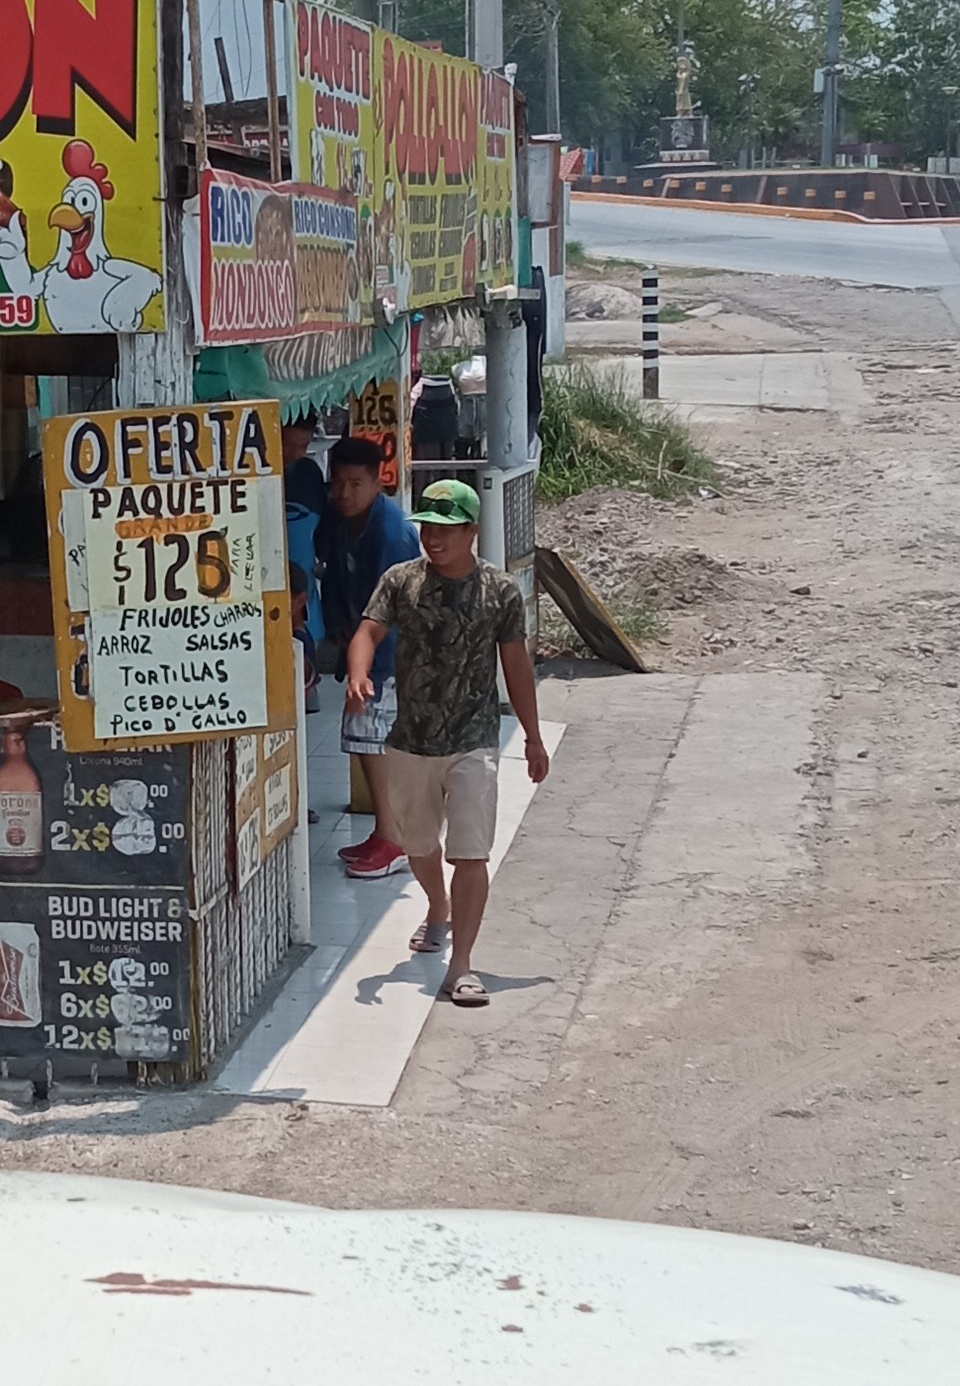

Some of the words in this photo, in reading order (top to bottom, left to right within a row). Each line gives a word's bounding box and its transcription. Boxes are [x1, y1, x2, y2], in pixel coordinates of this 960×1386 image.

[297, 2, 371, 100] PAQUETE
[211, 185, 253, 246] RICO
[294, 199, 317, 234] RICO
[0, 294, 33, 325] 59
[210, 258, 295, 330] MONDONGO
[65, 408, 272, 487] OFERTA
[89, 479, 249, 519] PAQUETE
[119, 605, 210, 631] FRIJOLES
[97, 634, 152, 656] ARROZ
[185, 631, 252, 651] SALSAS
[124, 692, 230, 712] CEBOLLAS
[48, 896, 94, 916] BUD
[99, 897, 162, 918] LIGHT
[51, 919, 182, 942] BUDWEISER
